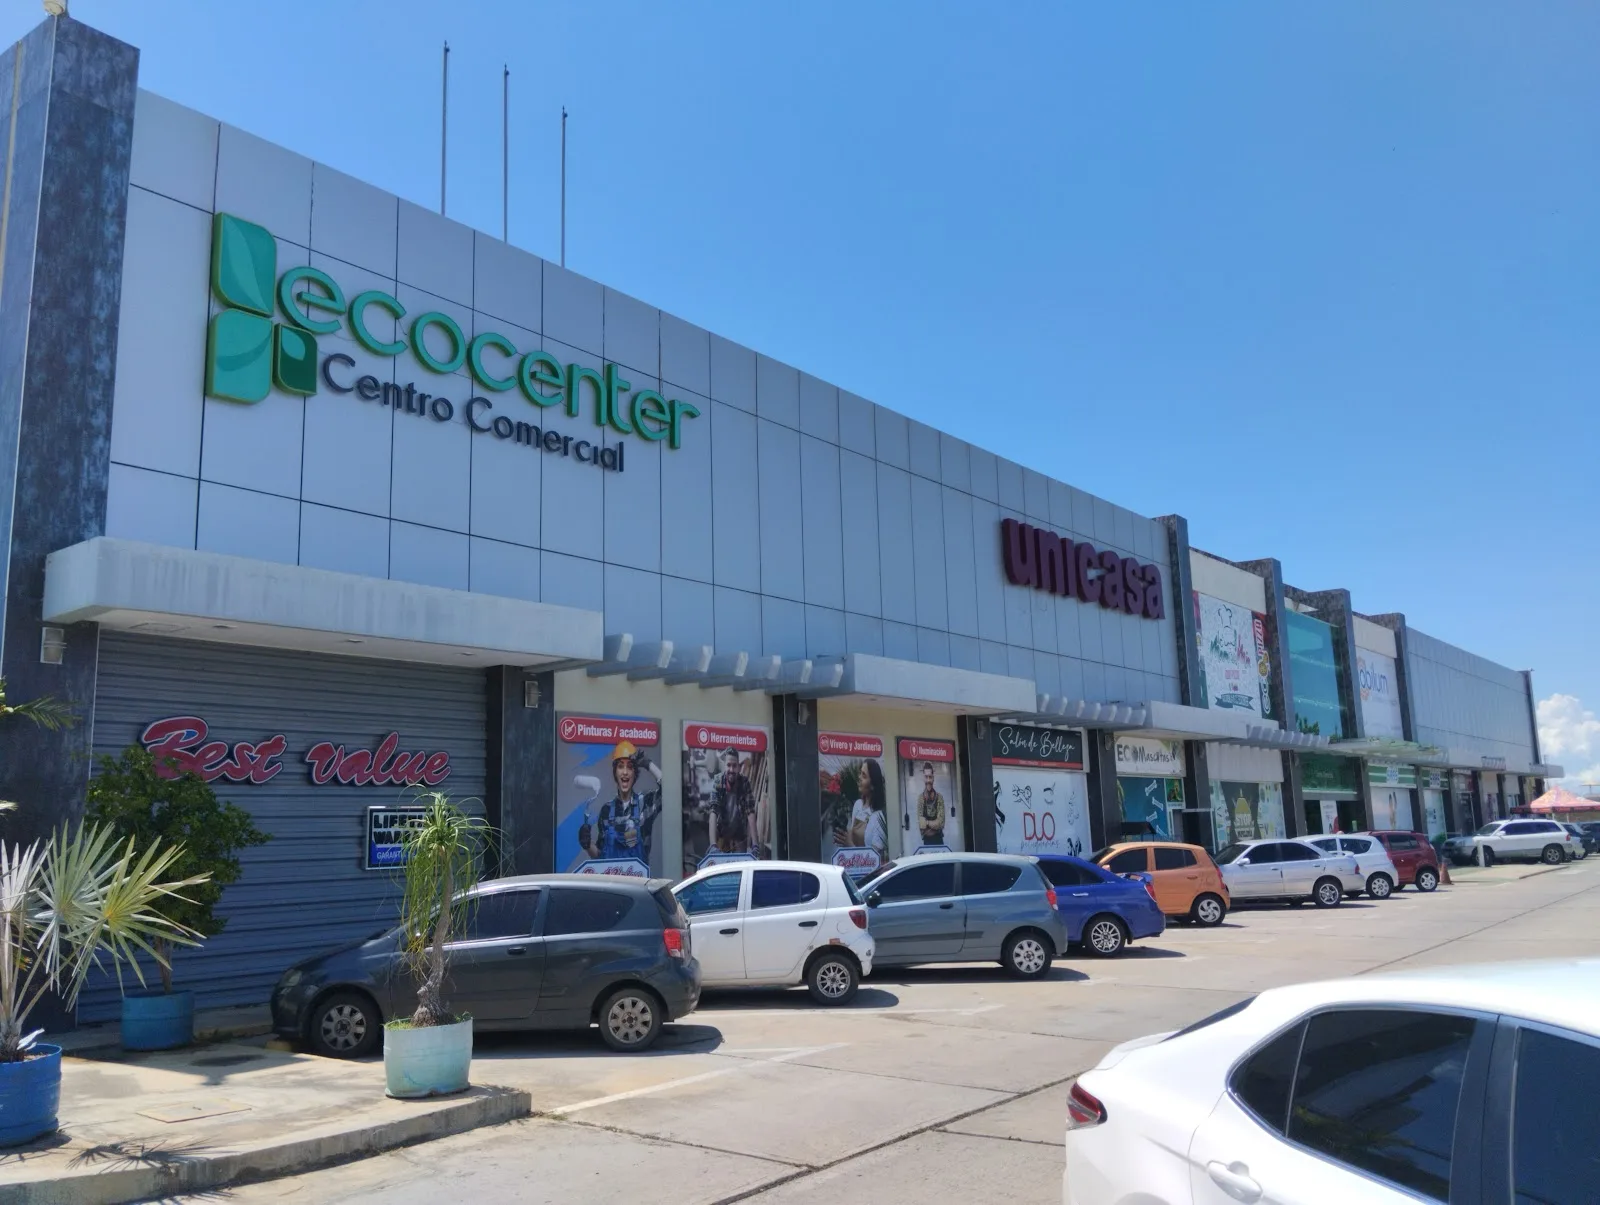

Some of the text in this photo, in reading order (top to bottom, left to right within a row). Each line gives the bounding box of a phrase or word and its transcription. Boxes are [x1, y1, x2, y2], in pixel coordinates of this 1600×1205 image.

[277, 265, 700, 449] ecocenter
[322, 353, 625, 472] Centro Comercial
[577, 724, 612, 737] Pinturas
[619, 727, 657, 739] acabados
[710, 732, 757, 746] Herramientas
[829, 739, 848, 750] Vivero
[849, 742, 854, 751] y
[1028, 731, 1038, 752] de
[1040, 731, 1075, 762] Belleza
[141, 716, 287, 784] Best
[1023, 812, 1055, 841] DUO
